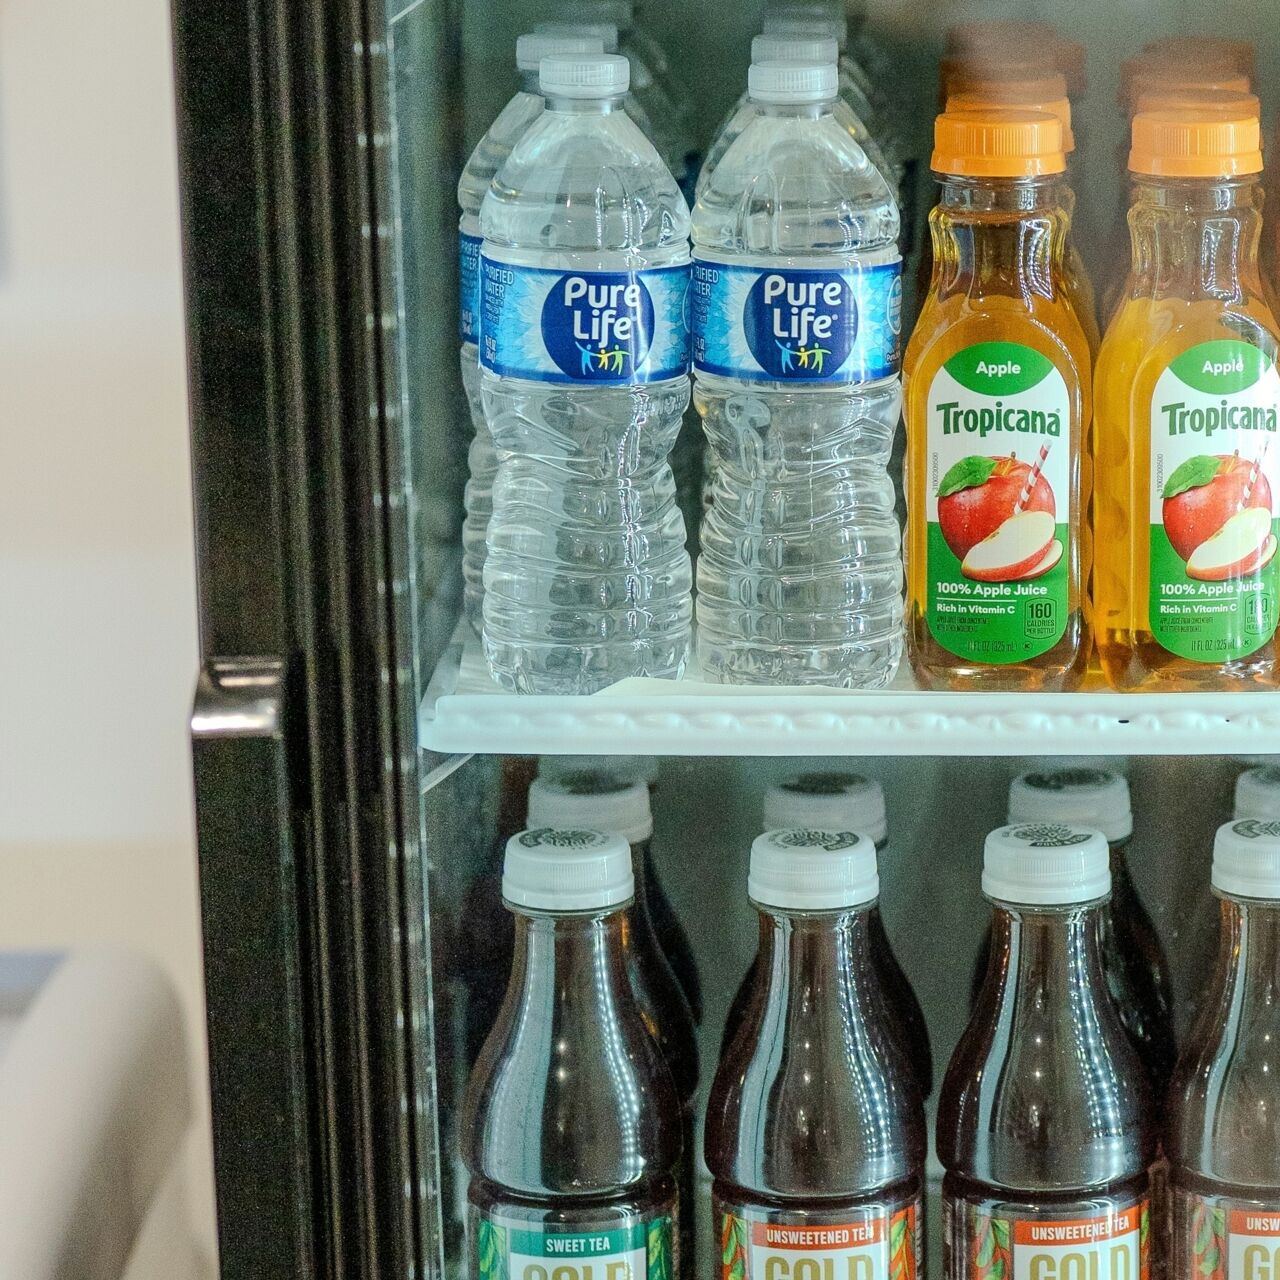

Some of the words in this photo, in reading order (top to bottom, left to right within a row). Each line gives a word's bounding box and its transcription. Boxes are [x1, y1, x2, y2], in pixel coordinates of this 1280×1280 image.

[564, 276, 641, 308] Pure
[764, 274, 842, 306] Pure
[574, 310, 631, 348] Life
[773, 307, 832, 347] Life
[976, 361, 1021, 377] Apple
[1202, 358, 1244, 376] Apple
[936, 401, 1061, 437] Tropicana
[1161, 399, 1277, 436] Tropicana
[937, 582, 971, 595] 100%
[973, 583, 1011, 598] Apple
[1014, 584, 1048, 595] Juice
[1160, 583, 1196, 595] 100%
[1198, 582, 1234, 596] Apple
[1236, 580, 1265, 592] Juice
[936, 603, 957, 613] Rich
[958, 604, 967, 613] in
[968, 605, 1005, 614] Vitamin
[1007, 606, 1015, 614] C
[1028, 602, 1052, 619] 160
[1160, 604, 1181, 614] Rich
[1182, 604, 1191, 613] in
[1193, 603, 1228, 613] Vitamin
[1230, 603, 1237, 612] C
[1026, 619, 1055, 627] CALORIES
[766, 1228, 849, 1245] UNSWEETENED
[853, 1225, 874, 1242] TEA
[1031, 1222, 1111, 1241] UNSWEETENED
[1114, 1216, 1130, 1231] TEA
[546, 1239, 585, 1252] SWEET
[589, 1237, 611, 1251] TEA
